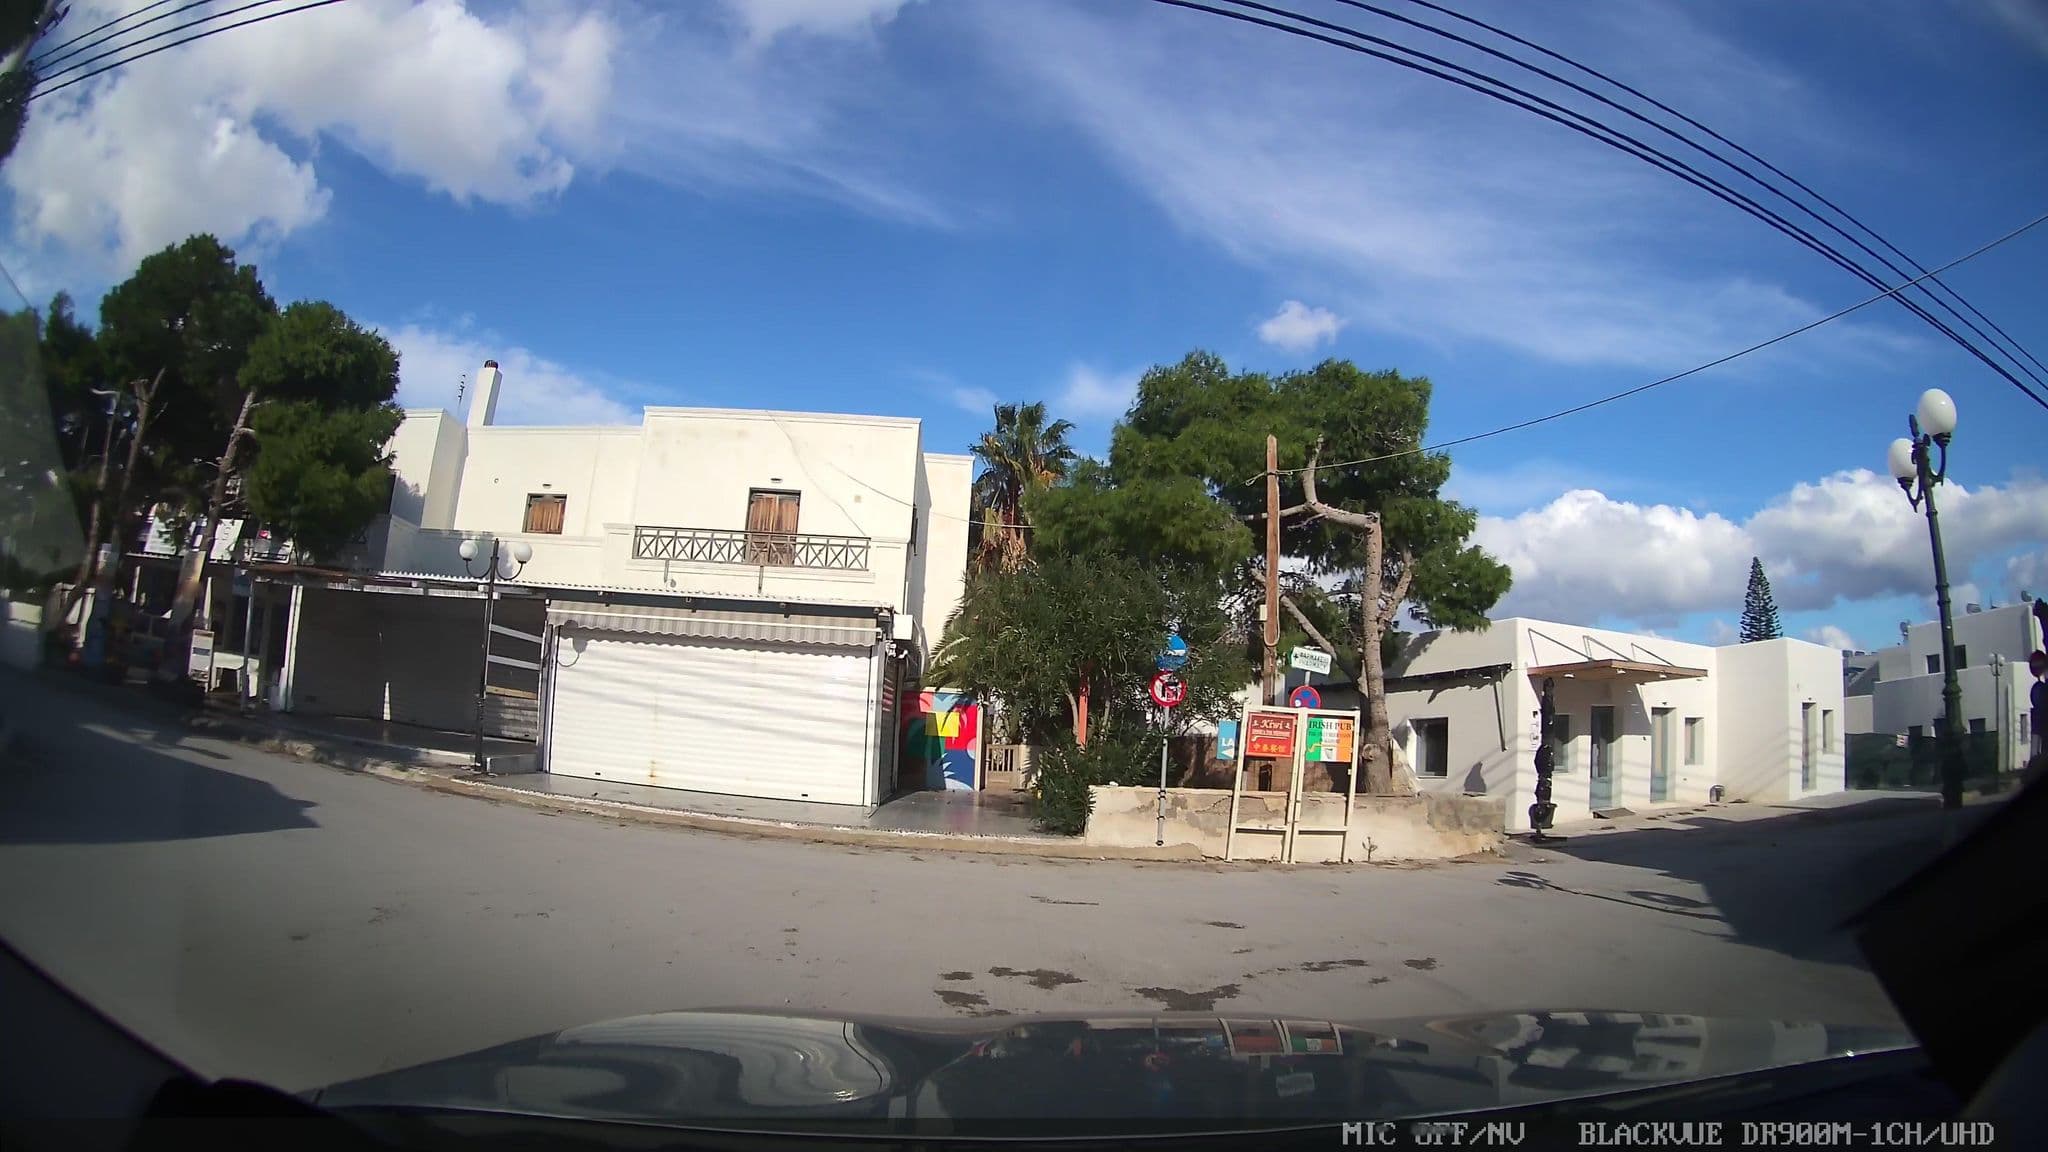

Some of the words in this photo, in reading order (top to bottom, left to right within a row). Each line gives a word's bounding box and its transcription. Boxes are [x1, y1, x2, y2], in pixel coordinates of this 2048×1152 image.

[1260, 719, 1283, 730] Kiwi
[1308, 720, 1334, 730] IRISH
[1334, 722, 1352, 731] PUB
